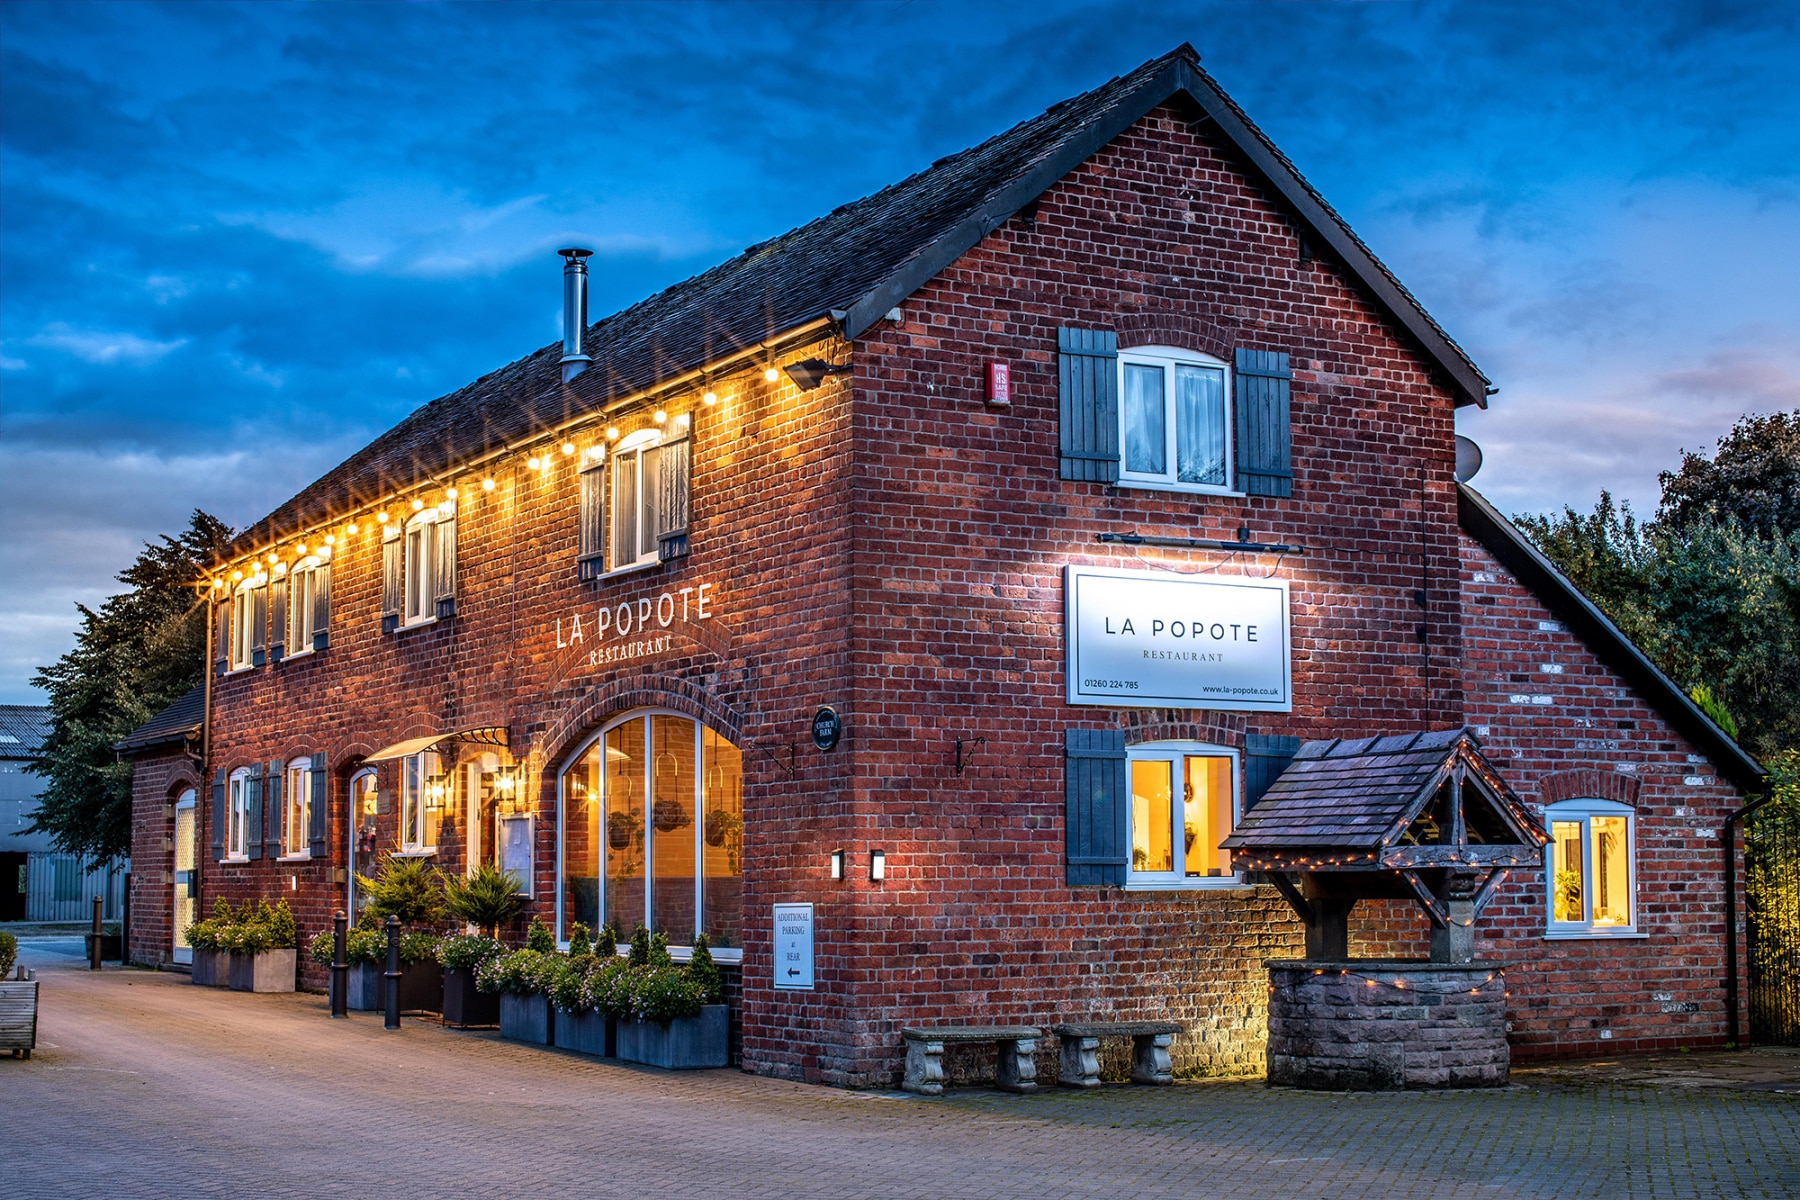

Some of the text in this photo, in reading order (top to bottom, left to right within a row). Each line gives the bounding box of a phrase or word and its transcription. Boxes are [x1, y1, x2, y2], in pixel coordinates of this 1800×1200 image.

[556, 583, 712, 649] LA POPOTE
[1105, 616, 1258, 642] LA POPOTE
[590, 635, 672, 666] RESTAURANT
[1143, 649, 1224, 663] RESTAURANT
[1084, 679, 1139, 689] 01260 224 785
[1203, 685, 1279, 696] www.la-popote.co.uk
[777, 913, 809, 922] ADDITIONAL
[781, 926, 805, 935] PARKING
[786, 953, 801, 961] REAR
